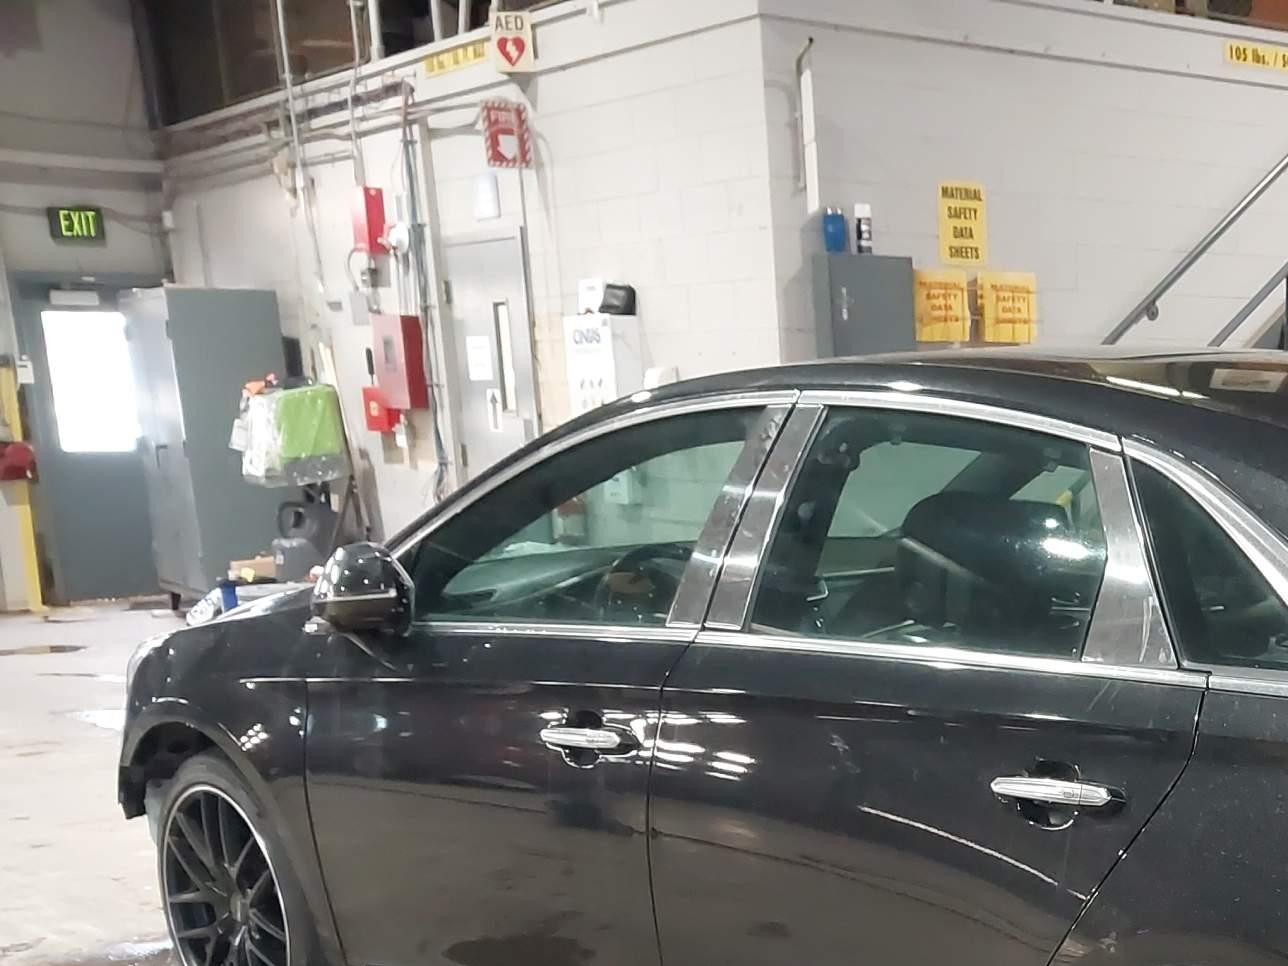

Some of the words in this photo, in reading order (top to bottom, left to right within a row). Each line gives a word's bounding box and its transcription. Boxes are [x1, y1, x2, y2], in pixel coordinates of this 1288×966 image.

[495, 15, 524, 31] AED
[1229, 45, 1249, 62] 105
[941, 185, 982, 202] MATERIAL
[947, 205, 978, 221] SAFETY
[59, 210, 97, 237] EXIT
[953, 225, 974, 240] DATA
[948, 245, 980, 260] SHEETS
